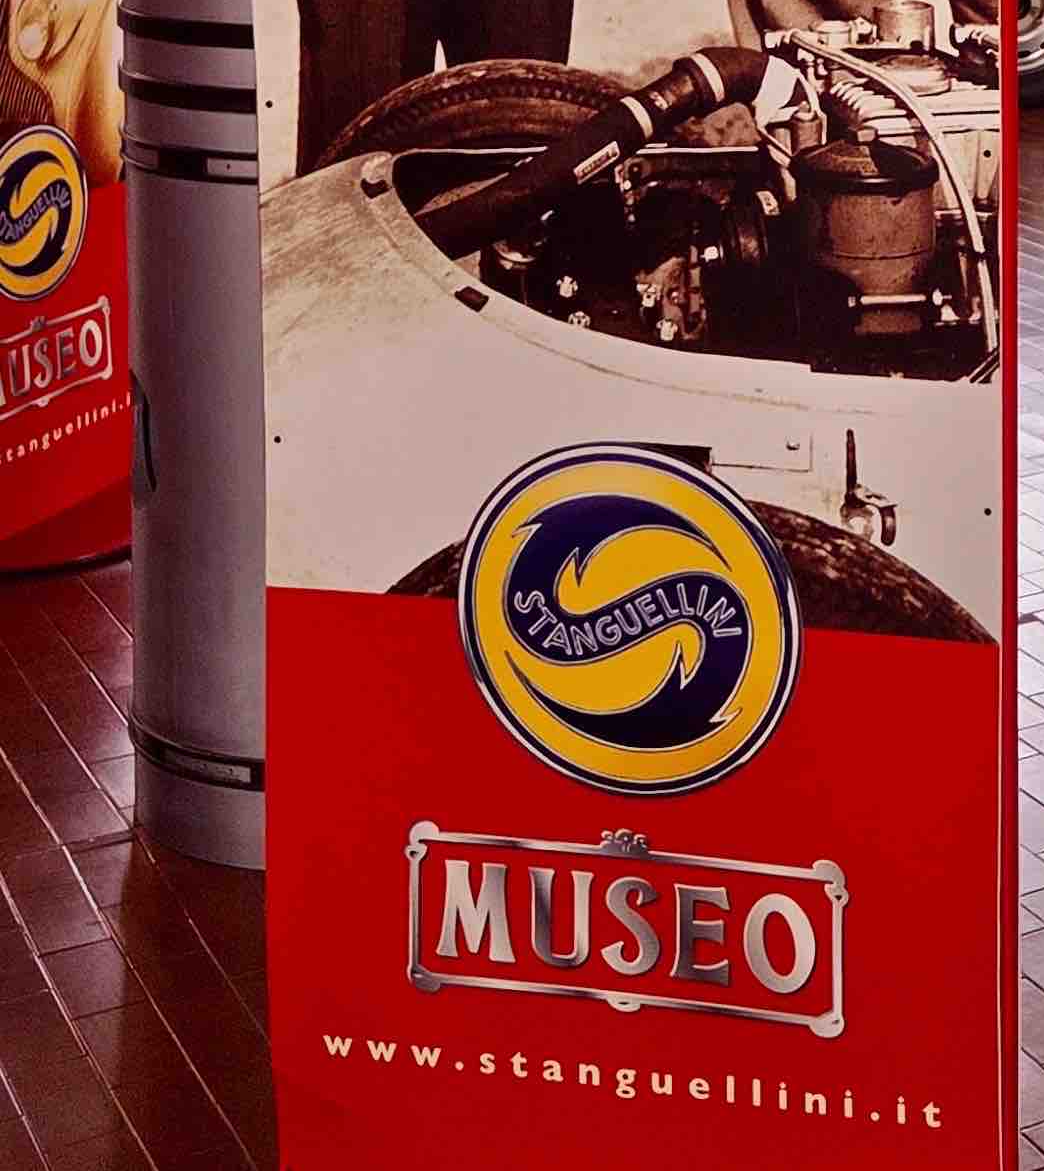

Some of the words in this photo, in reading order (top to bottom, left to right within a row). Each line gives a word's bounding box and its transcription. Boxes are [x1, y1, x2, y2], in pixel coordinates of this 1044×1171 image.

[513, 582, 743, 656] STANGUELLINI
[435, 859, 817, 995] MUSEO
[322, 1034, 943, 1129] www.stanguellini.it
